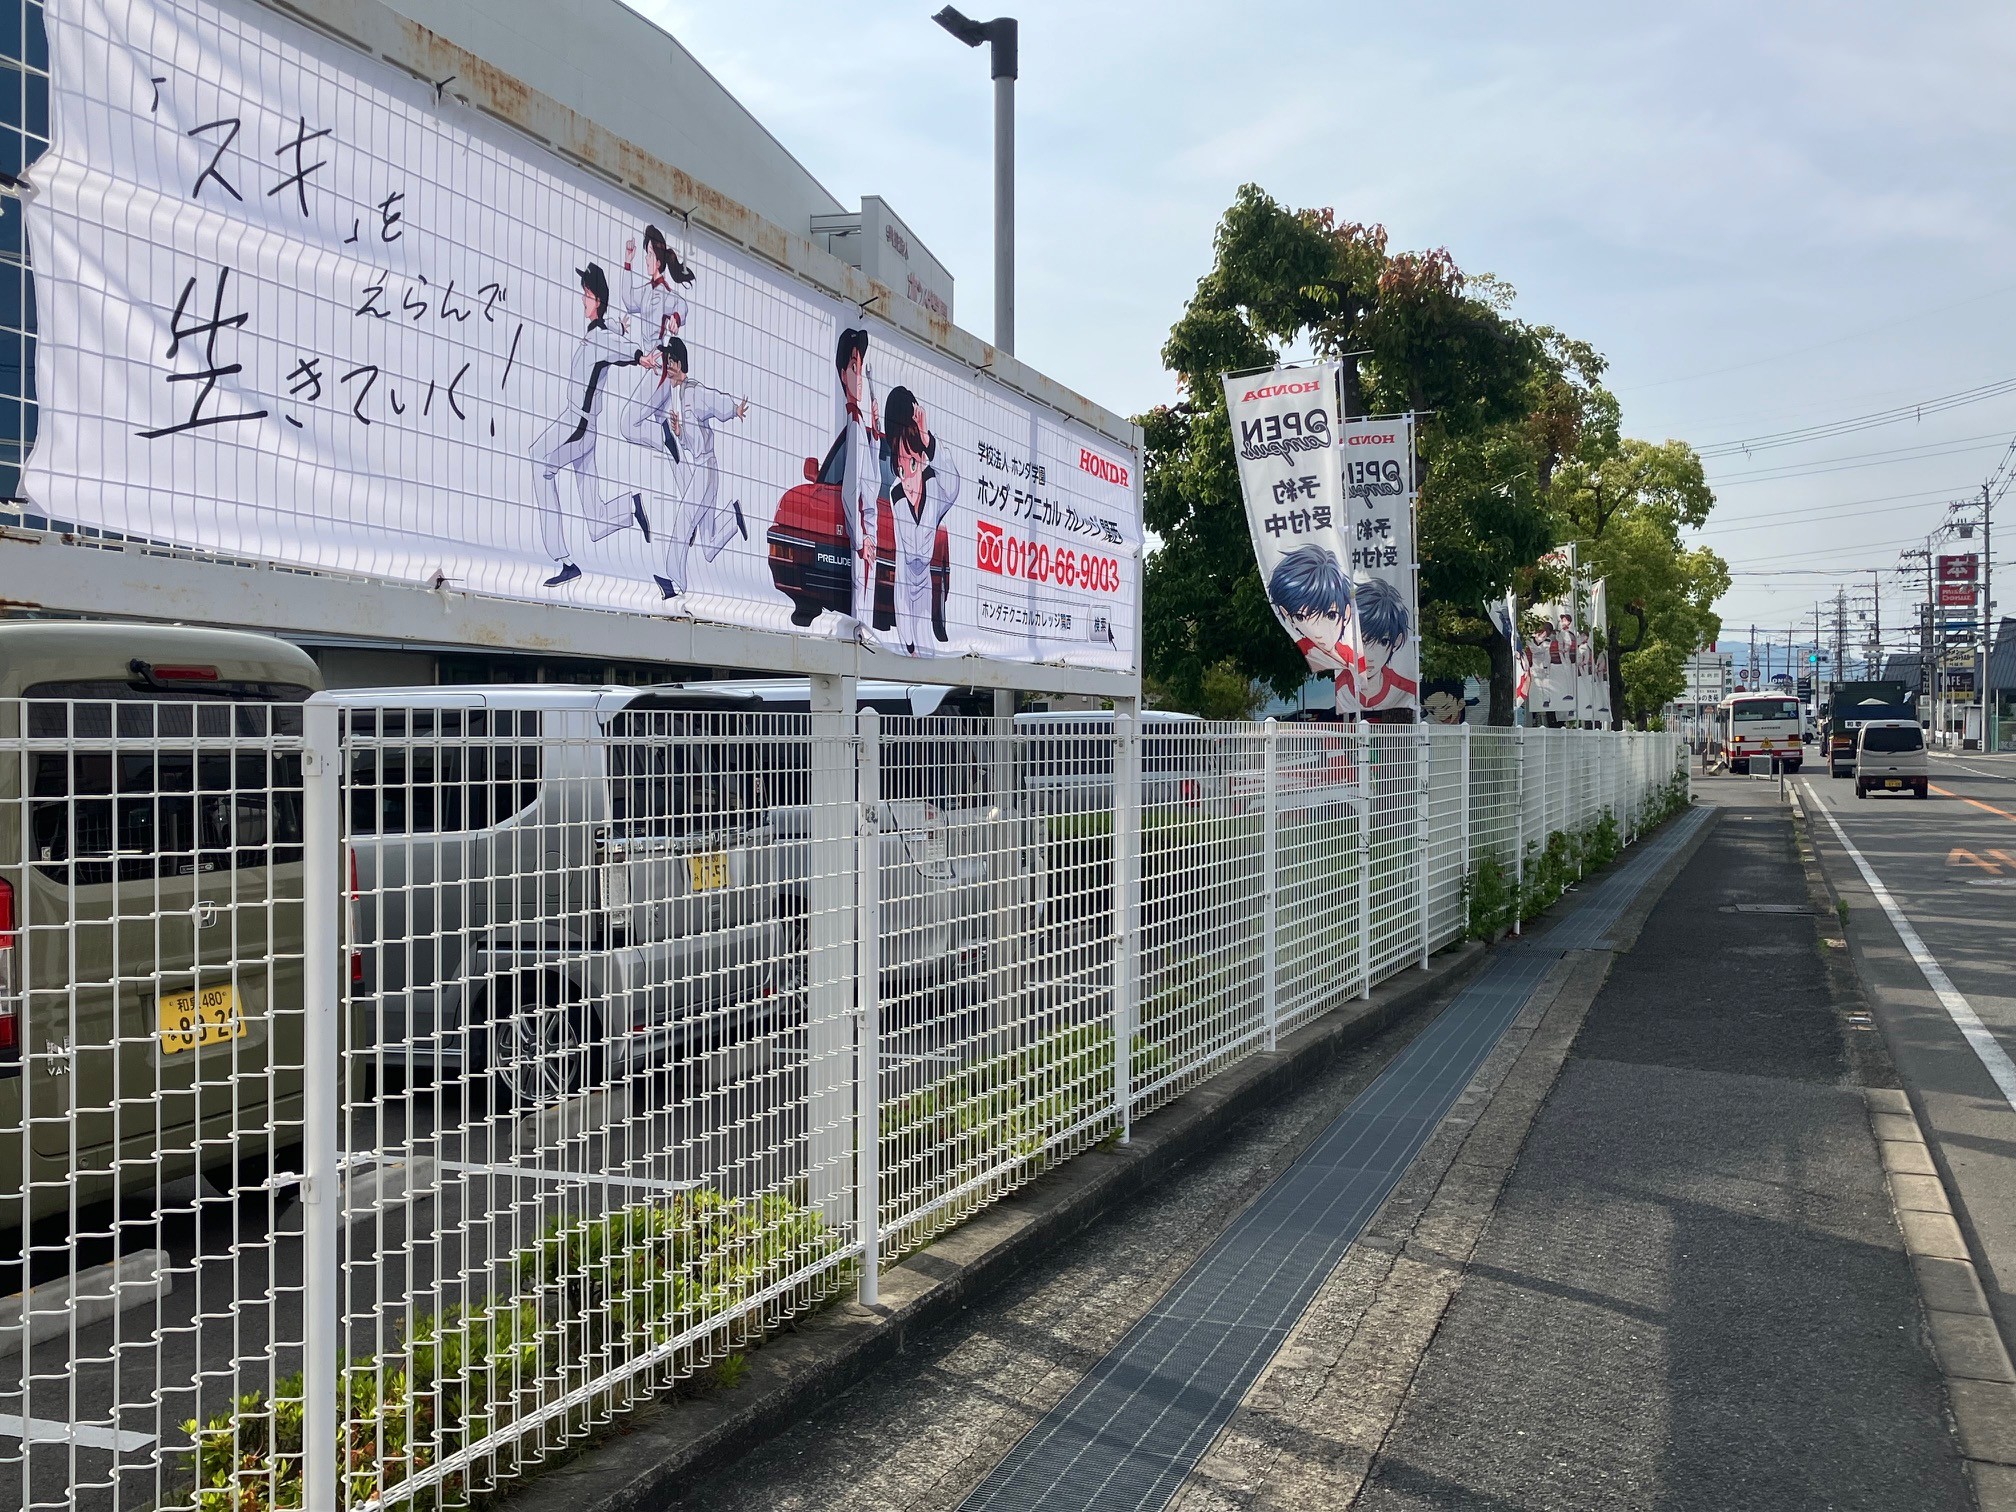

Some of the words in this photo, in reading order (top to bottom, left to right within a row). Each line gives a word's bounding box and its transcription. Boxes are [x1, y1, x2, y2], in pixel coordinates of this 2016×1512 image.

[355, 269, 507, 322] えらんで
[977, 440, 1009, 474] 学校法人
[1011, 456, 1046, 486] ホンダ学園
[1079, 448, 1129, 487] HONDA
[977, 475, 1011, 511] ホンダ
[1014, 489, 1061, 527] テクニカル
[817, 552, 851, 567] PRELUDE
[1006, 536, 1120, 592] 0120-66-9003
[202, 991, 222, 1008] 480
